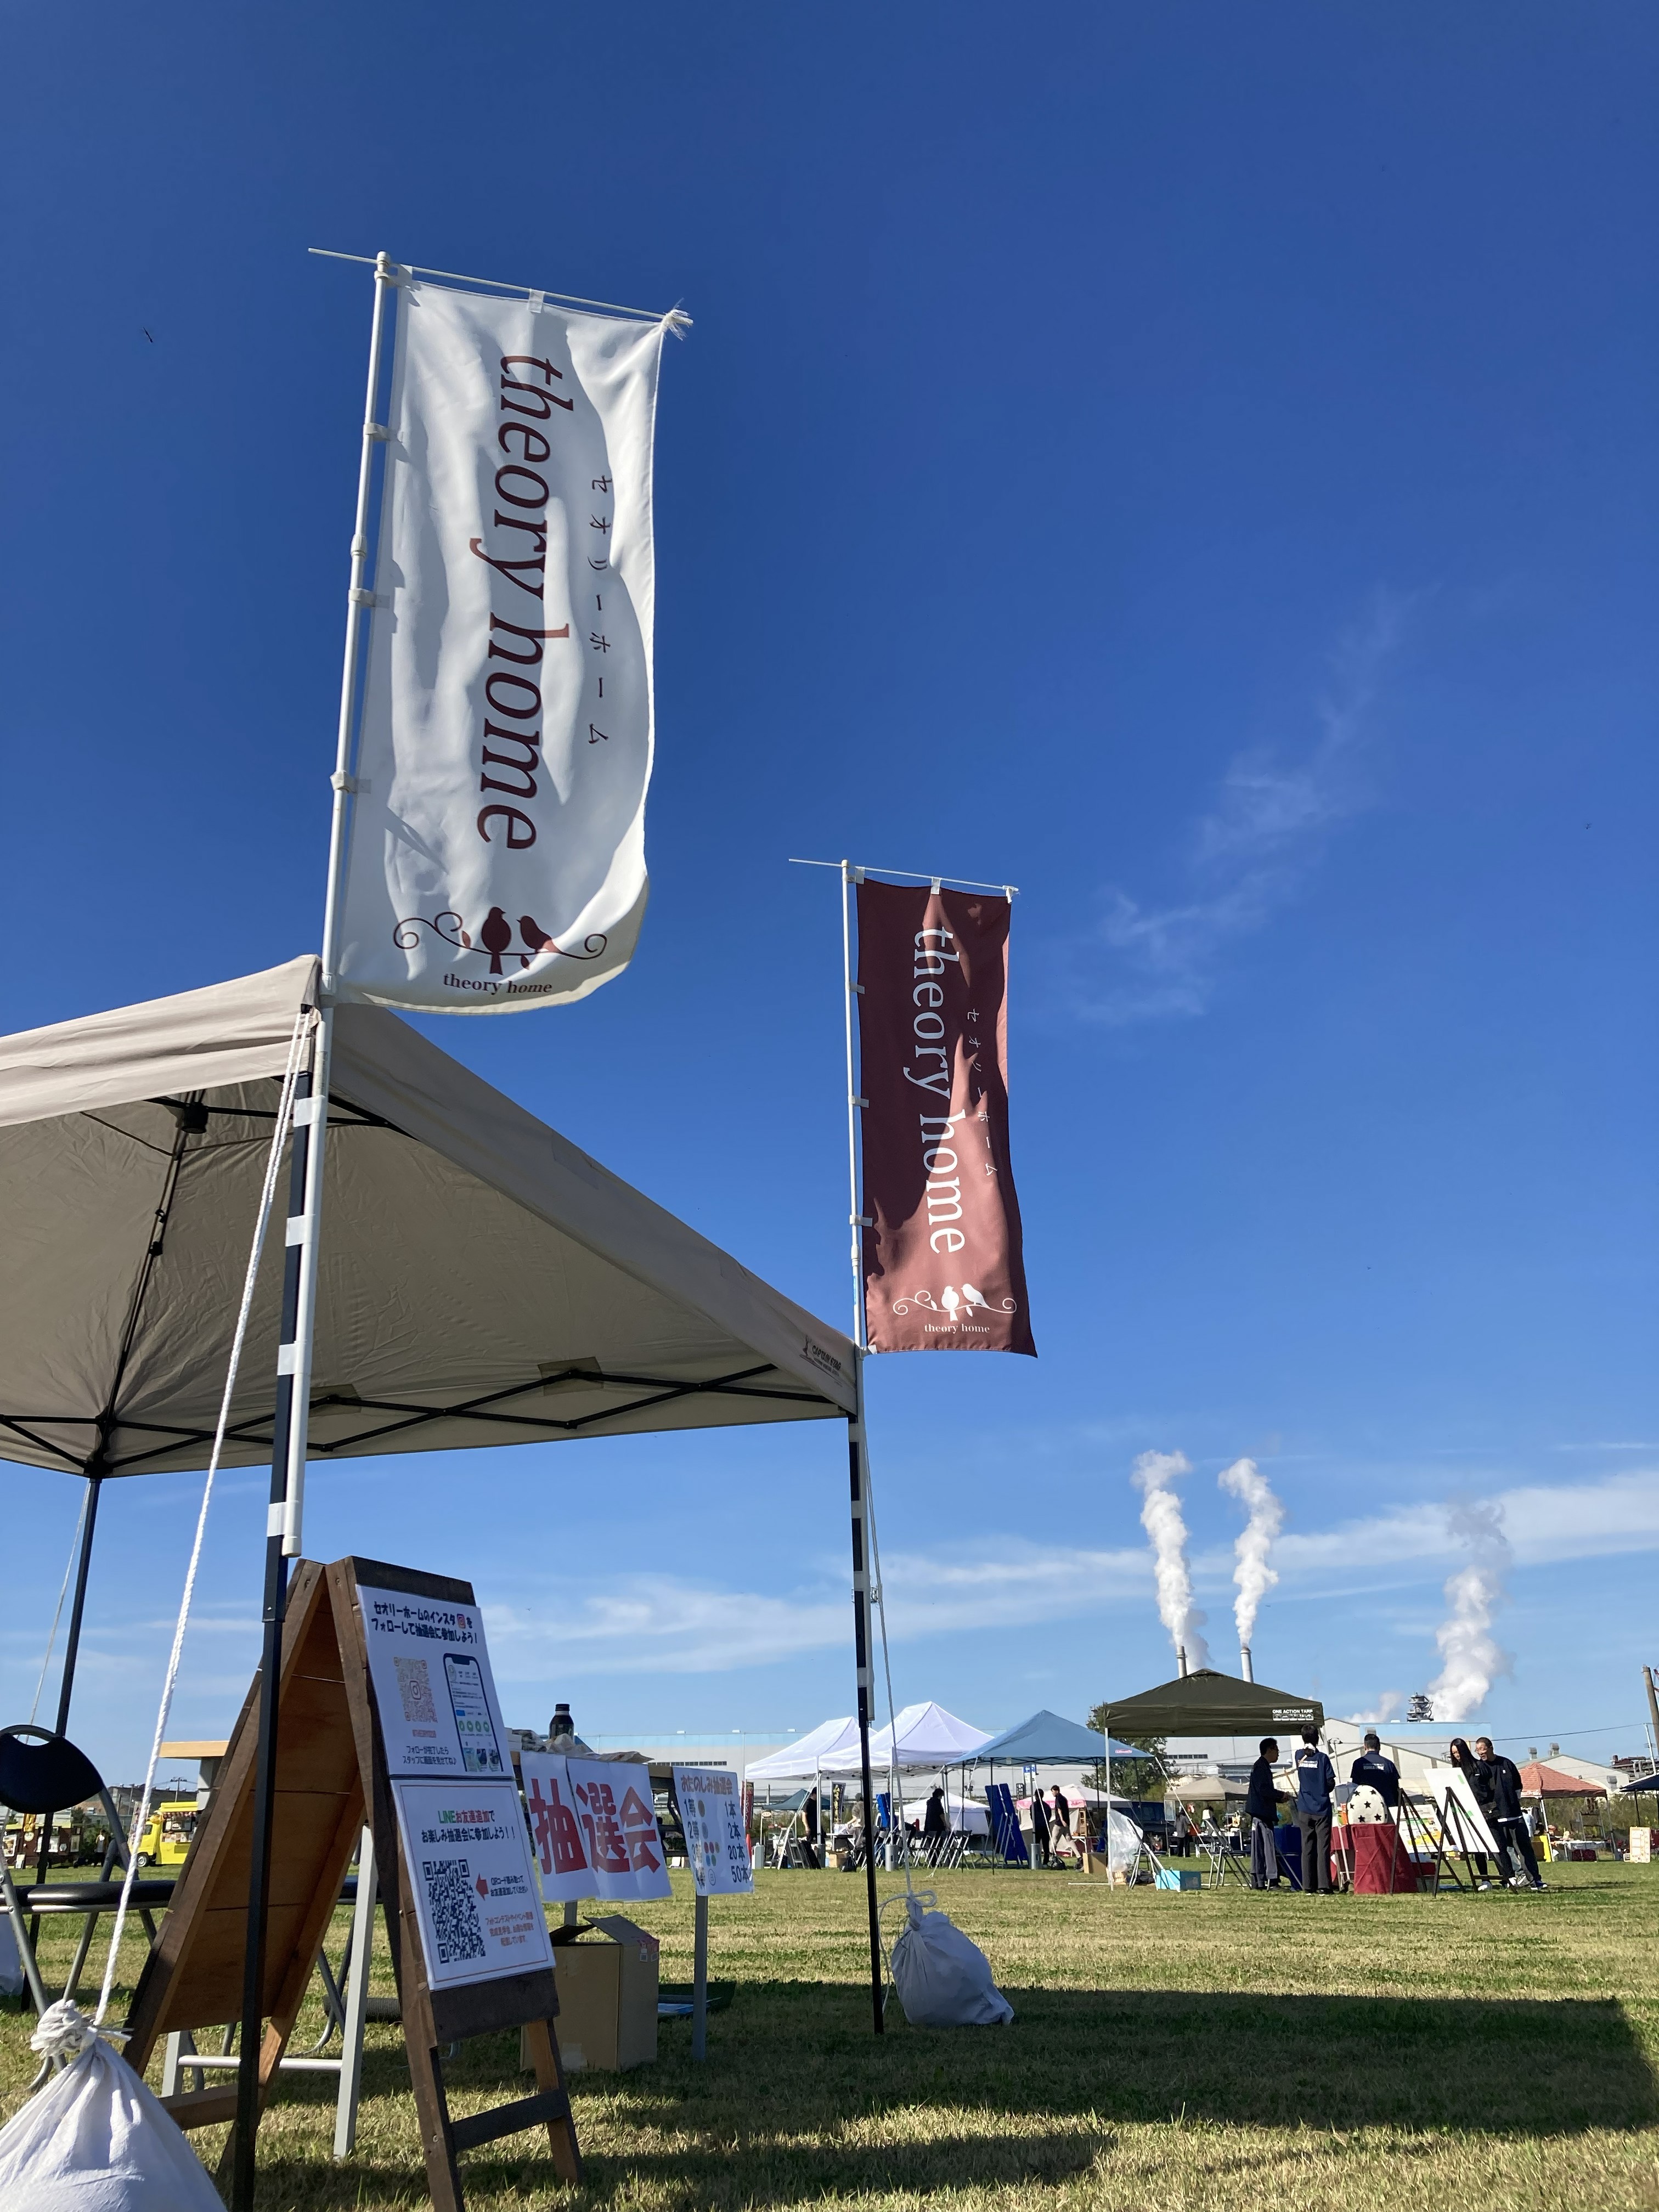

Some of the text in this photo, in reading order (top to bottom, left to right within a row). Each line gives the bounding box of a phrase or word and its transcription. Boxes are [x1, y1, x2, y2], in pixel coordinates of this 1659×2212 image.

[469, 355, 573, 850] theory home
[588, 475, 612, 745] セオリーホーム
[443, 973, 552, 995] theory home
[903, 926, 966, 1254] theory home
[924, 1323, 990, 1334] theory home
[529, 1778, 661, 1875] 抽選会
